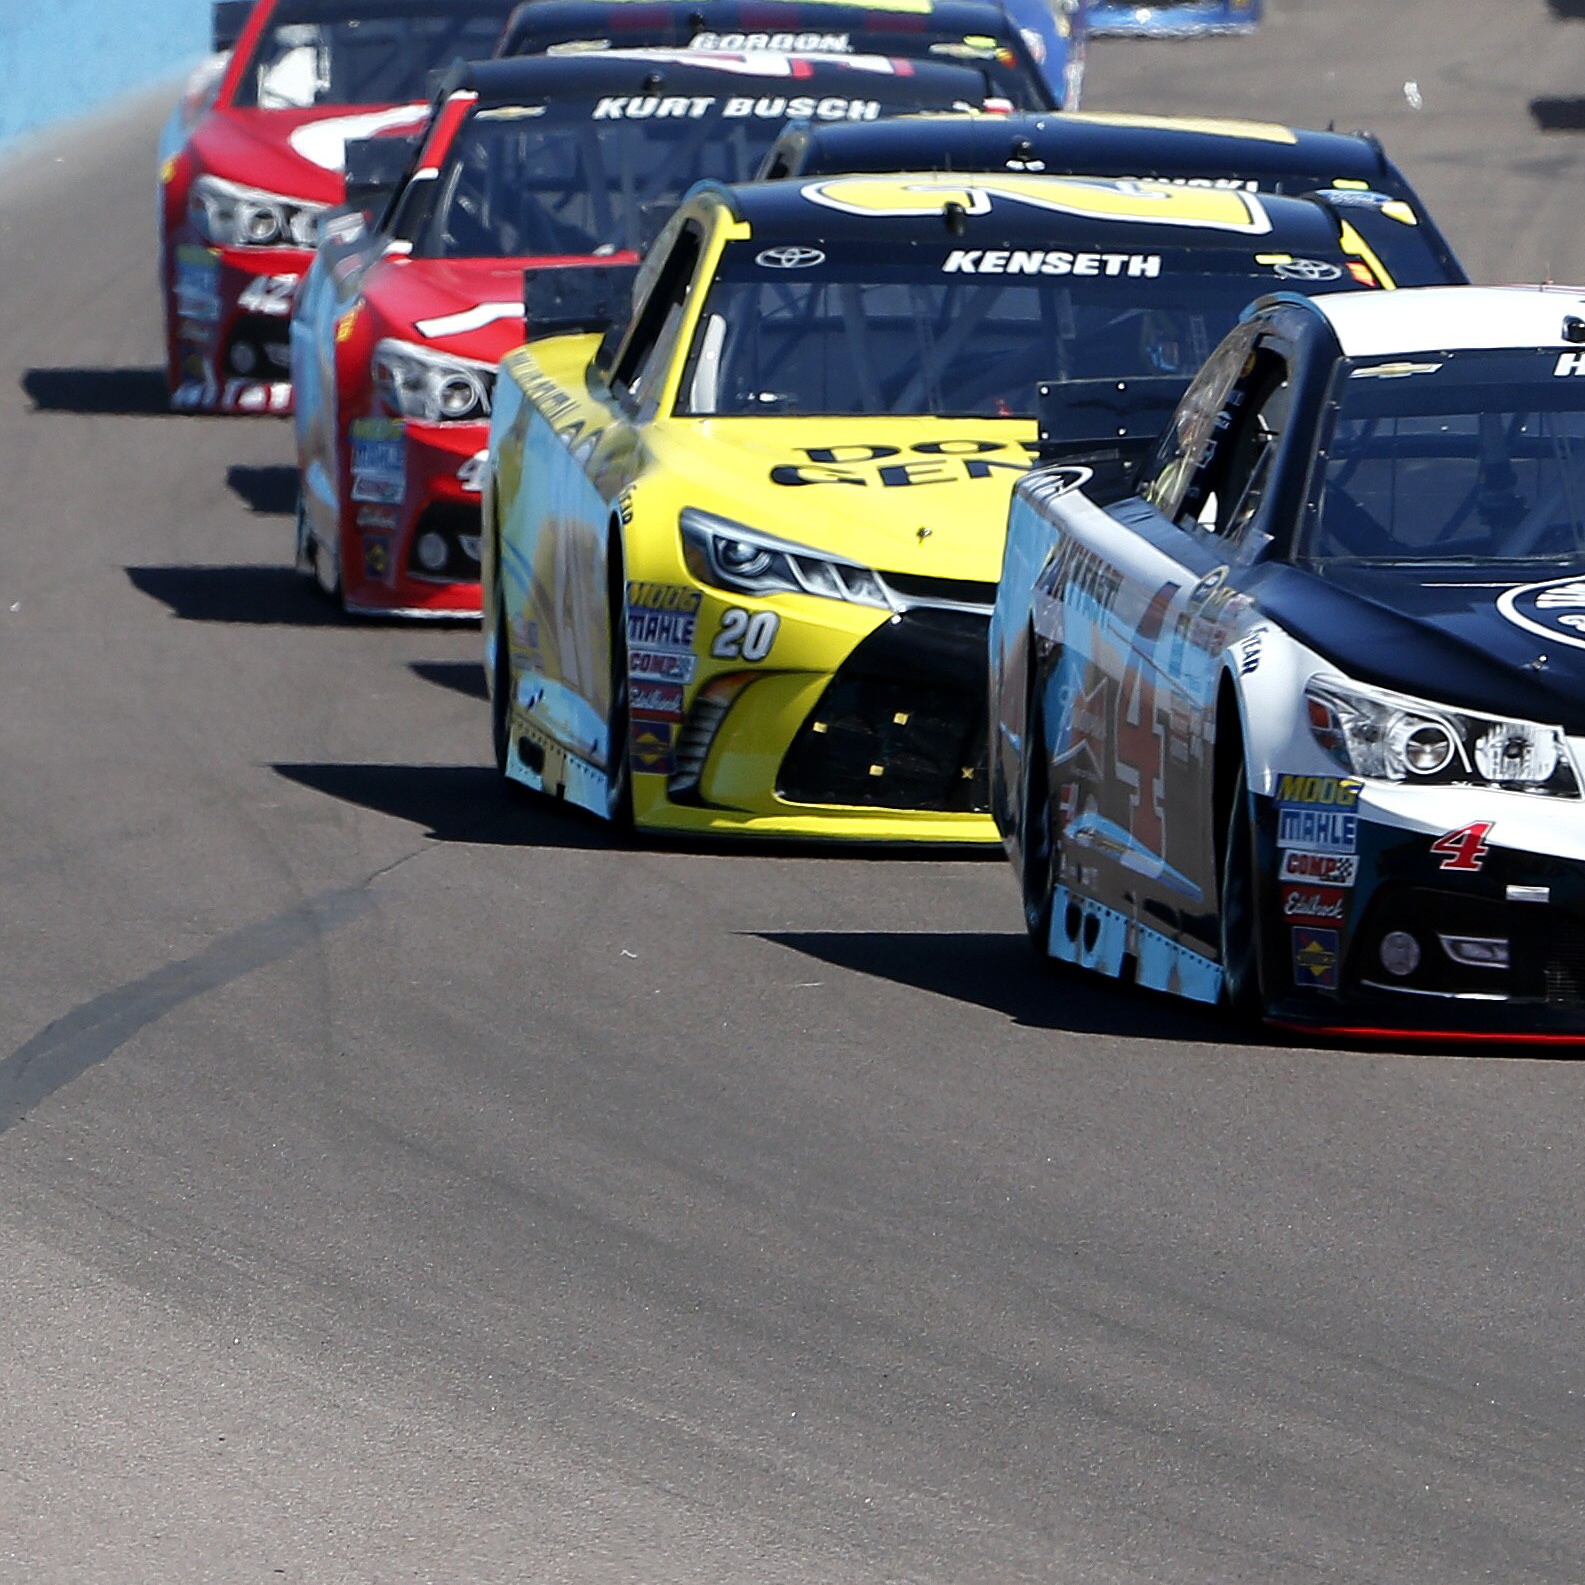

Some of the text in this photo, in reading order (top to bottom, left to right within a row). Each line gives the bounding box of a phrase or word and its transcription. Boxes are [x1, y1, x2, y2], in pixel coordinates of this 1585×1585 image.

[591, 95, 883, 122] KURT BUSCH
[942, 248, 1162, 279] KENSETH
[629, 614, 695, 644] MAHLE
[710, 605, 781, 662] 20
[1277, 774, 1361, 806] MOOG
[1280, 811, 1356, 846] MAHLE
[1429, 819, 1497, 872] 4
[1286, 852, 1339, 876] COMP
